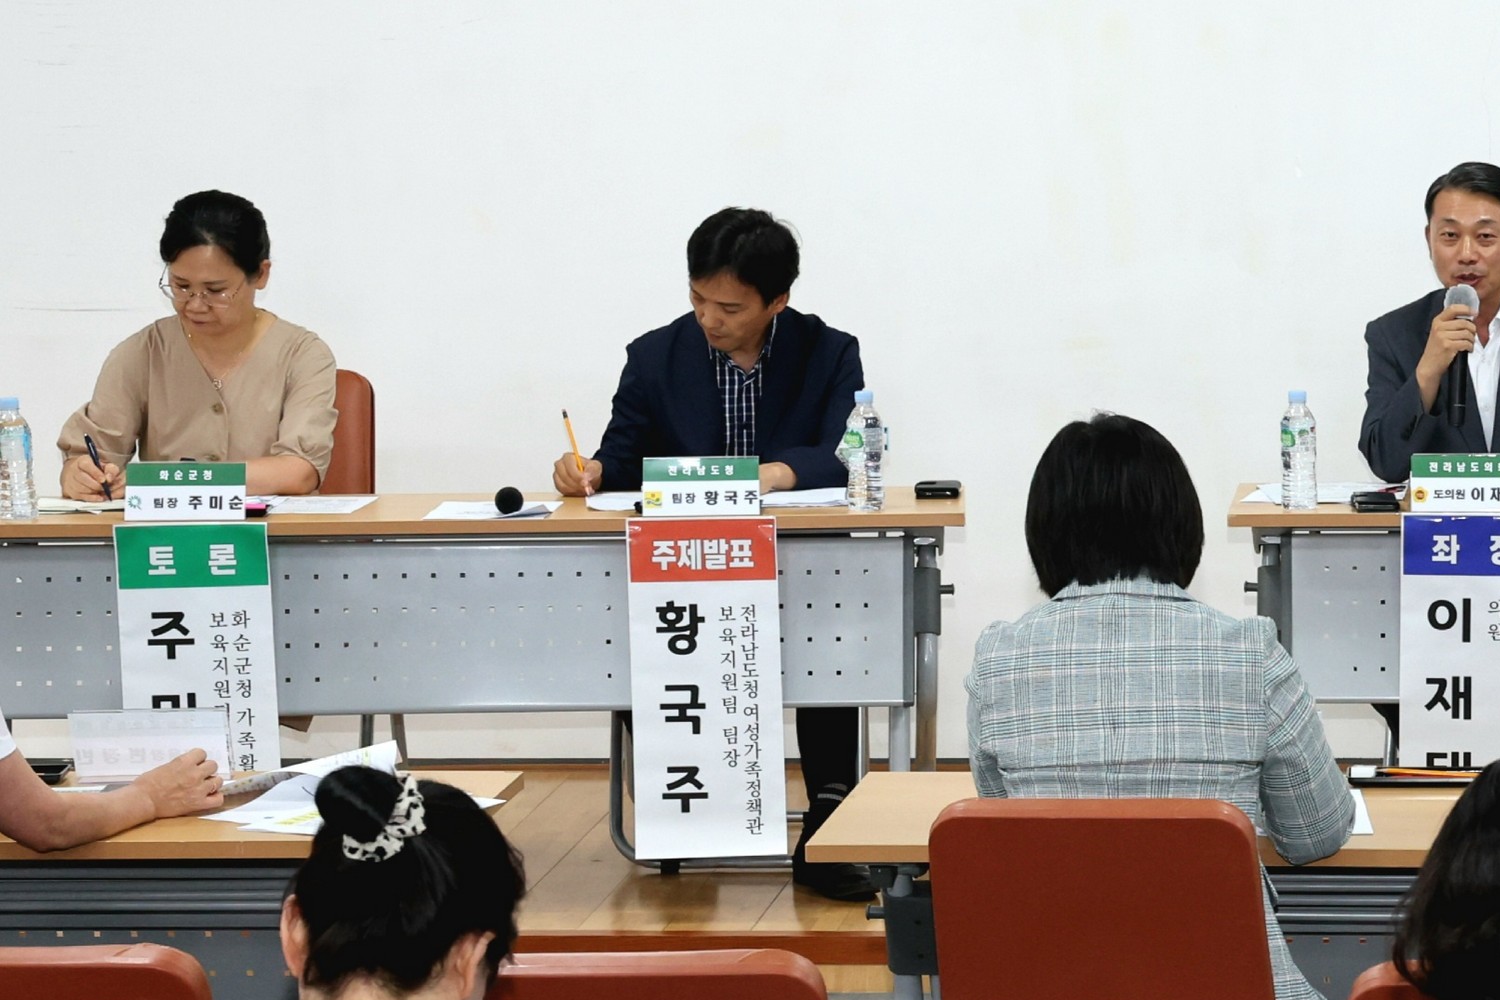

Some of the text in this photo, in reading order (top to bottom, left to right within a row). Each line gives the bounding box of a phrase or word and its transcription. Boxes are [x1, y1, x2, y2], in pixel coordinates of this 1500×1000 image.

[158, 469, 214, 481] 화순군청
[667, 464, 735, 476] 전라남도청
[153, 494, 244, 510] 팀장 주미순
[671, 489, 759, 506] 팀장 황국주
[1433, 488, 1467, 501] 도의원
[651, 538, 756, 571] 주제발표
[230, 609, 253, 699] 화순군청
[718, 605, 742, 769] 보육지원팀 팀장
[655, 600, 709, 814] 황국주
[740, 603, 765, 836] 전라남도청 여성가족정책관
